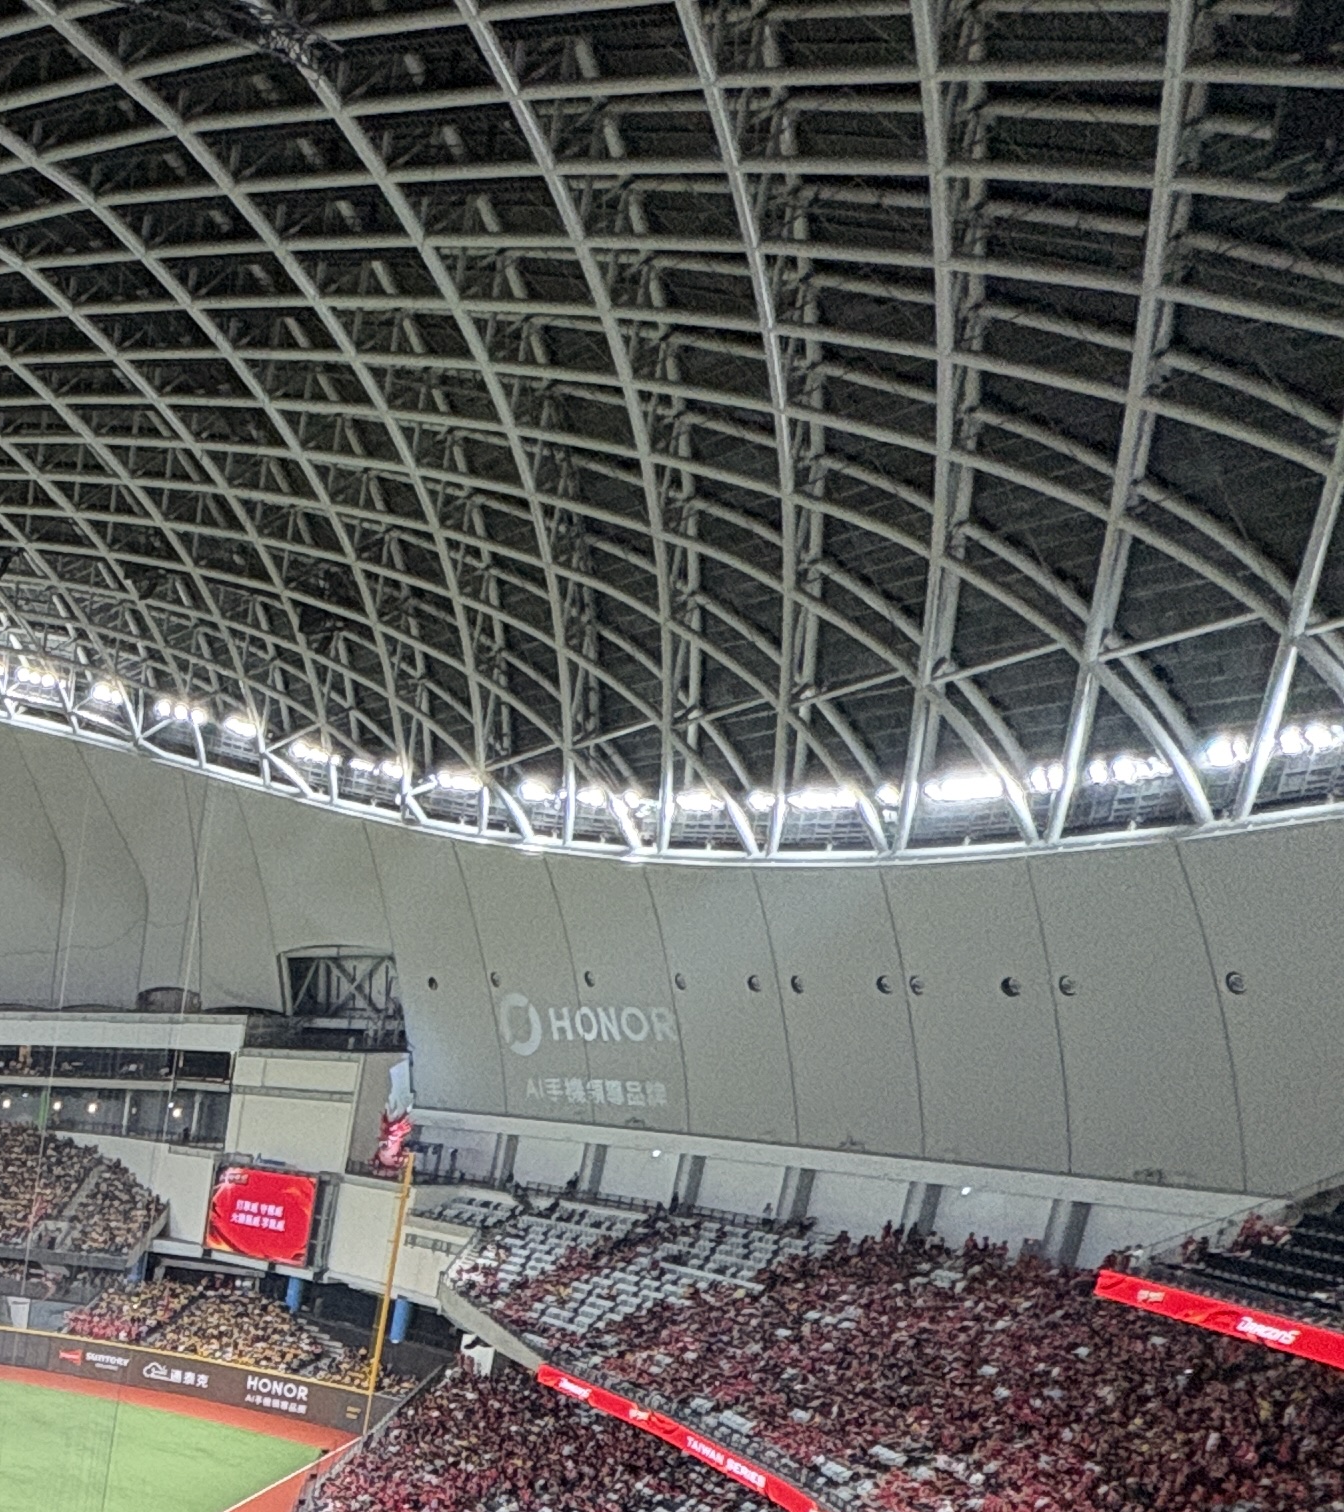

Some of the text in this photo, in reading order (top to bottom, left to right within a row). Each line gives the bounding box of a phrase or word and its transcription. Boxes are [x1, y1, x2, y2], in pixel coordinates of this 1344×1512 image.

[548, 1006, 677, 1042] HONOR
[246, 1375, 309, 1402] HONOR
[686, 1435, 724, 1467] TAIWAN
